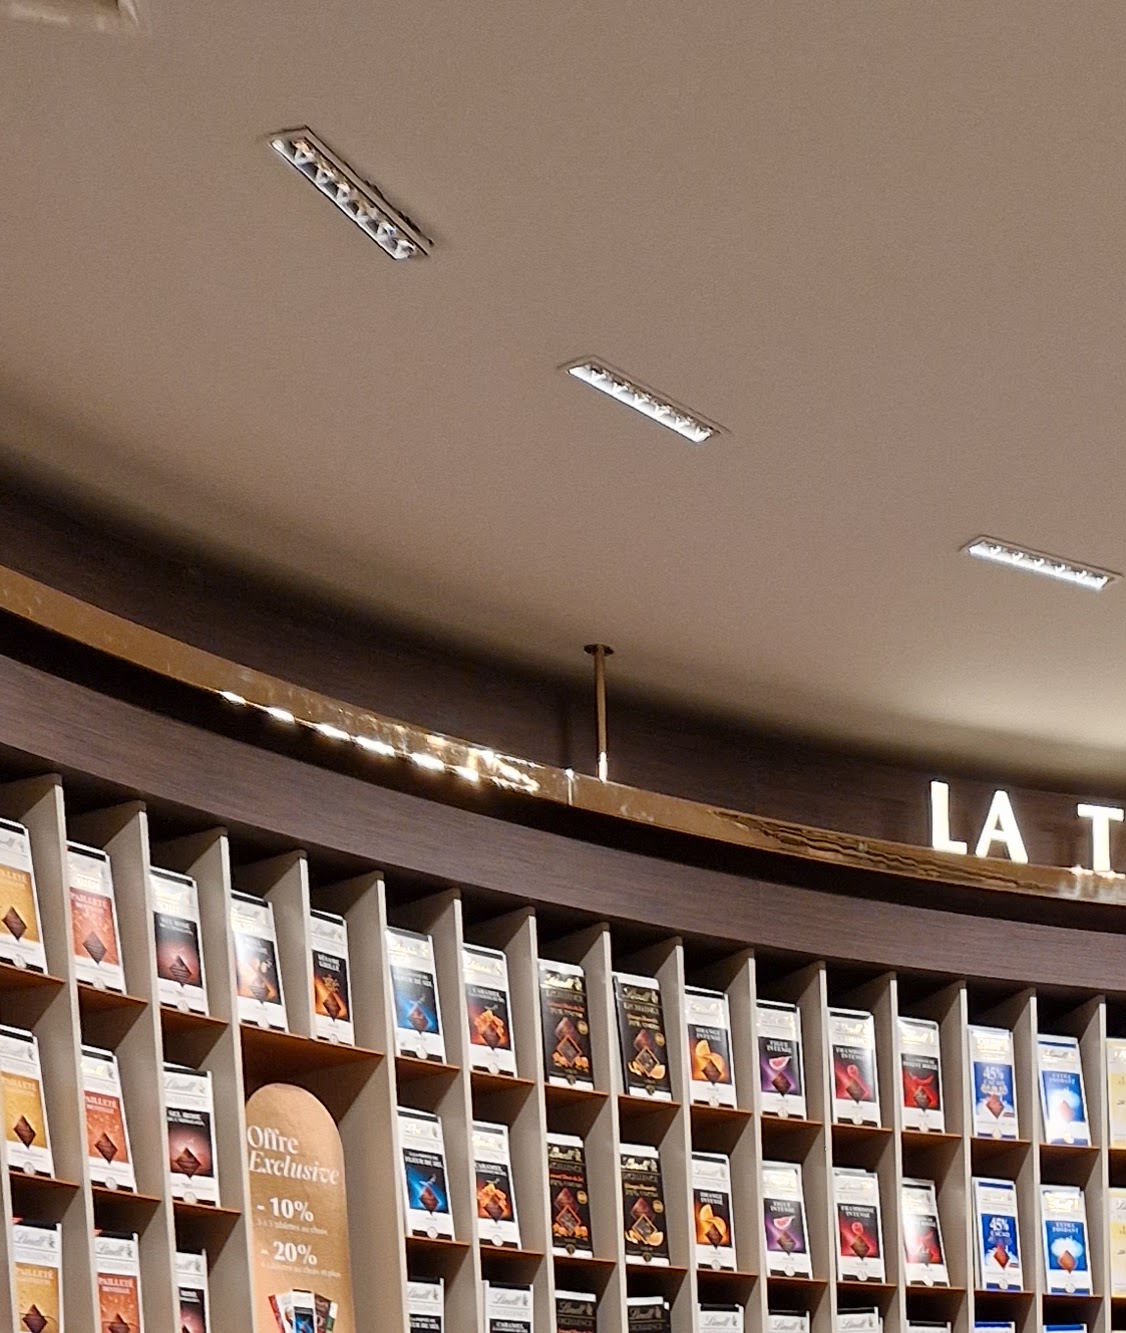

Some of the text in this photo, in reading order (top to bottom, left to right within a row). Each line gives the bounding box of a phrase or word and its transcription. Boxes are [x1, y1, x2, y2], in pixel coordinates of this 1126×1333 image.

[929, 778, 1029, 863] LA
[247, 1125, 299, 1155] Offre
[249, 1150, 340, 1185] Exclusive
[269, 1197, 314, 1221] 10%
[272, 1241, 318, 1265] 20%
